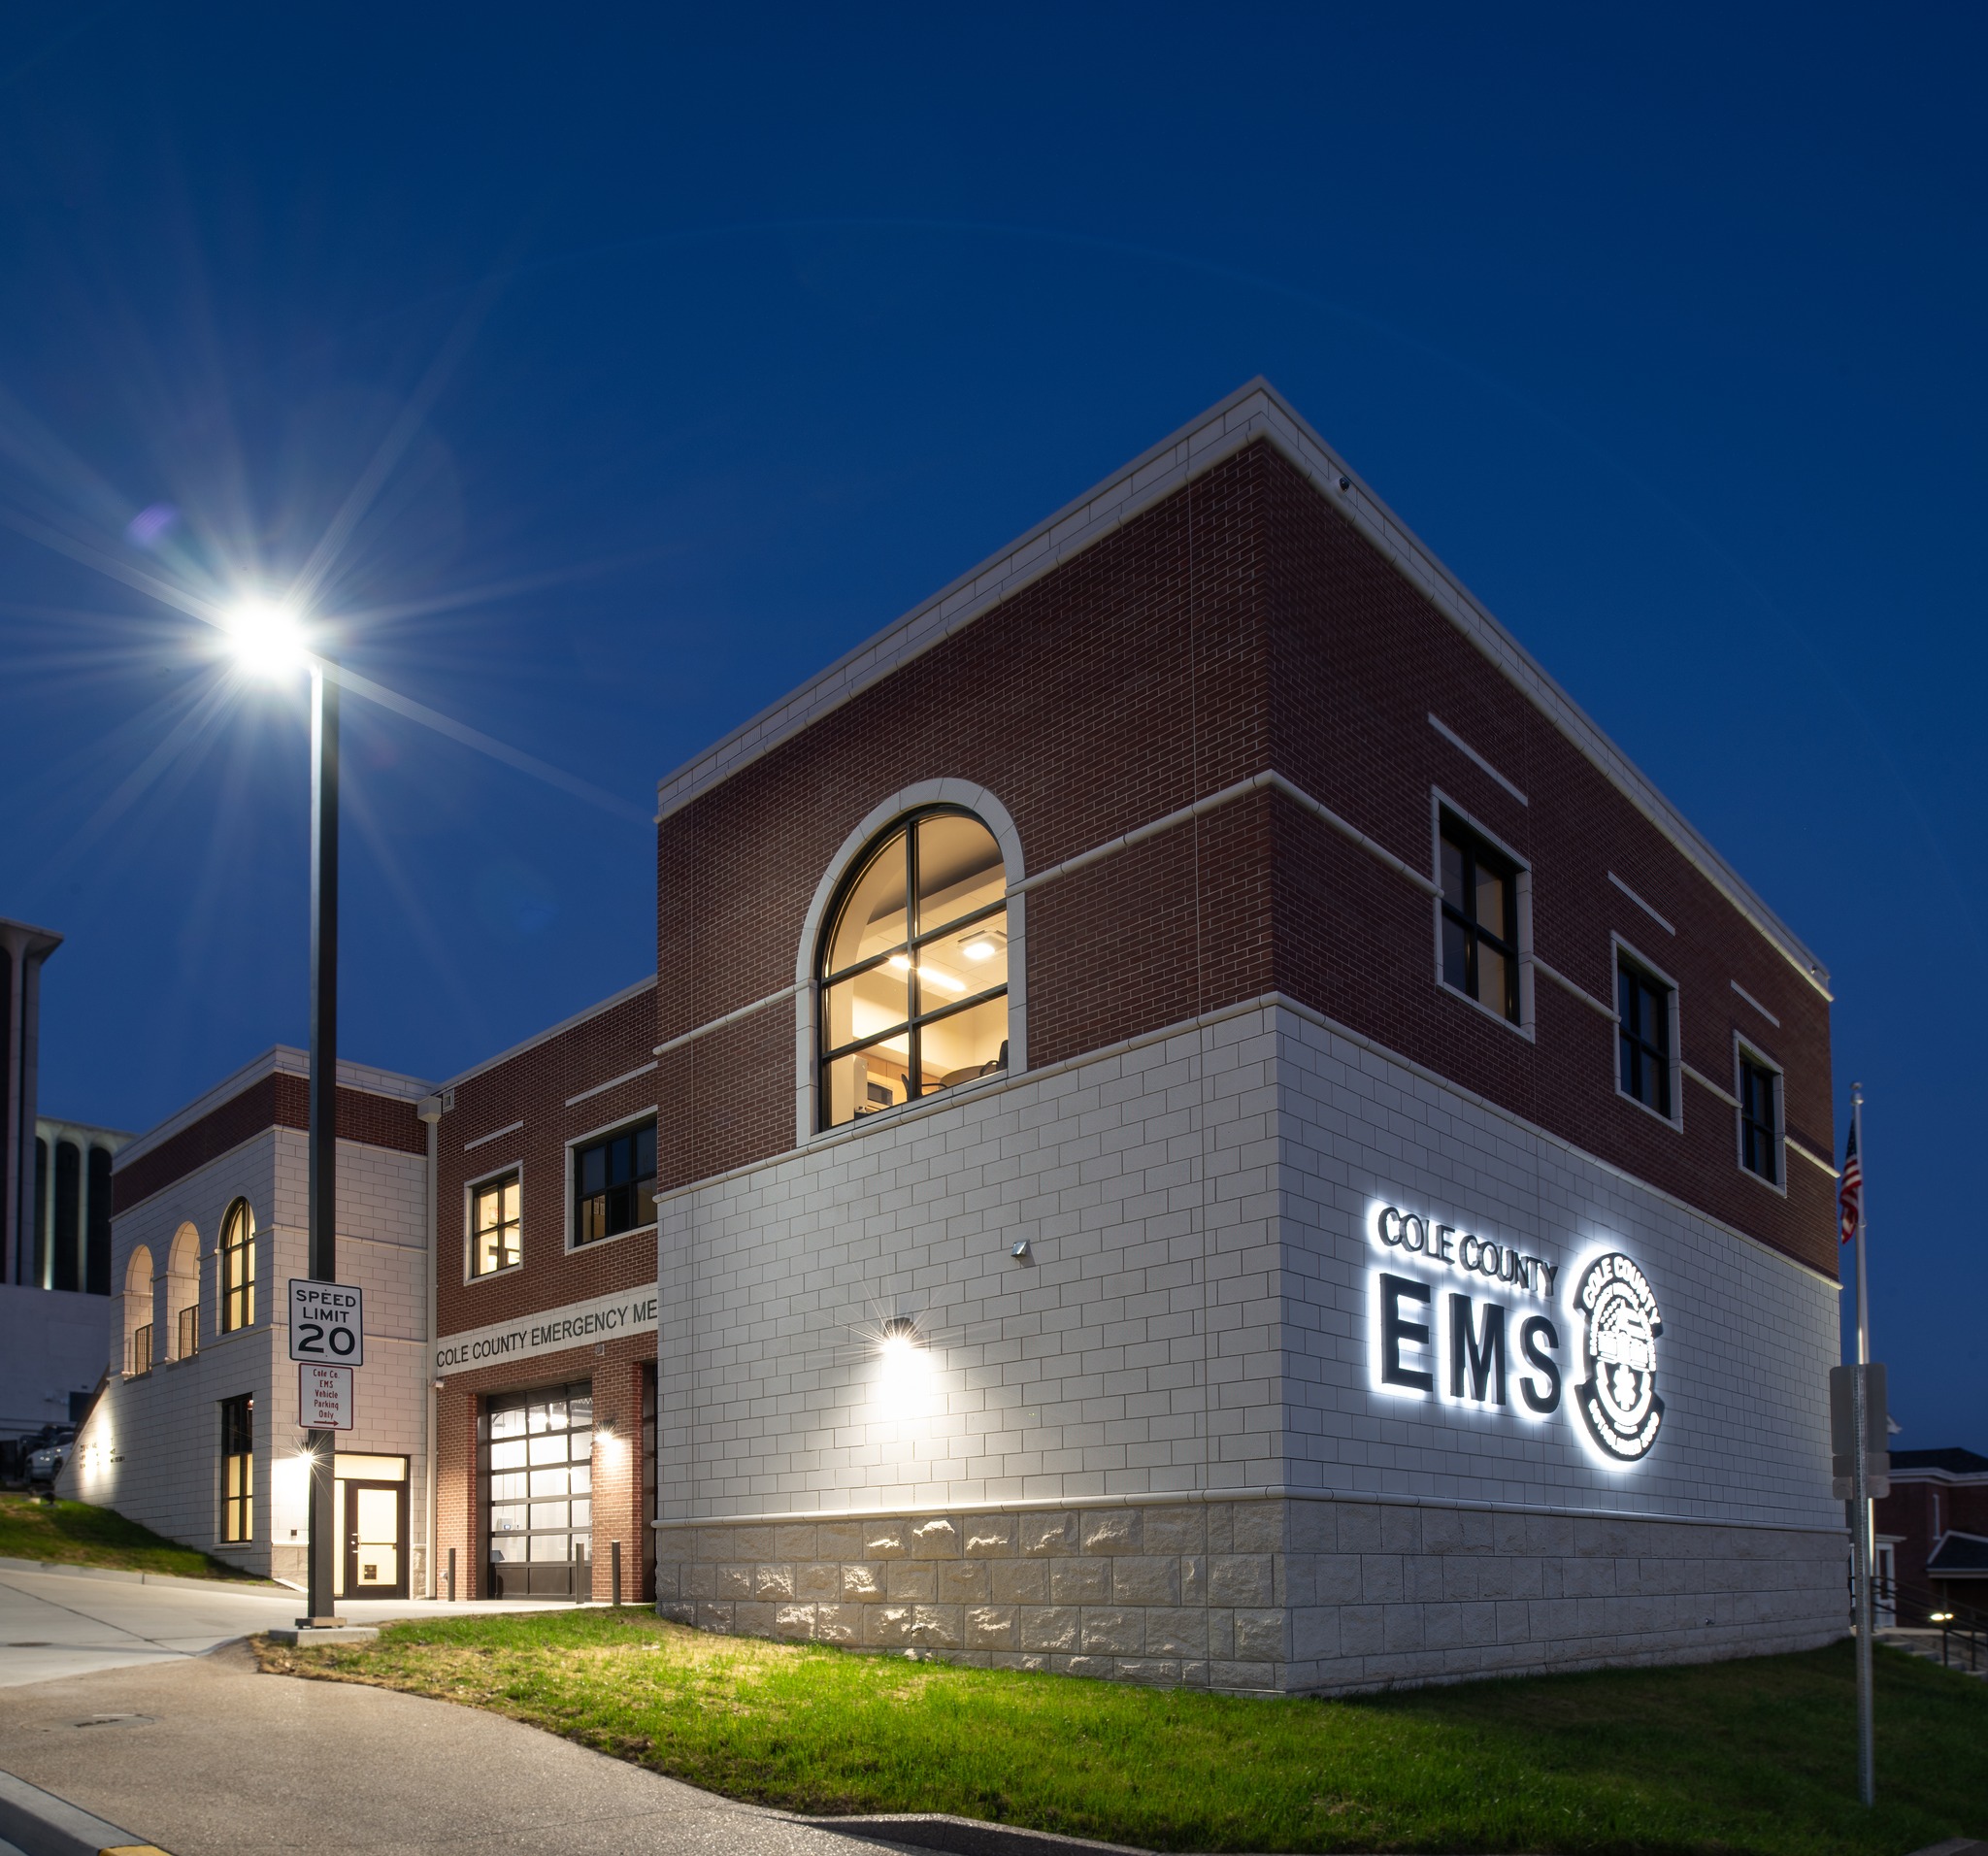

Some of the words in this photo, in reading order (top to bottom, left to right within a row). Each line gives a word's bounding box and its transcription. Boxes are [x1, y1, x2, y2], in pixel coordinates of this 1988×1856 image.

[1377, 1207, 1455, 1265] COLE
[1459, 1235, 1559, 1296] COUNTY
[296, 1289, 356, 1308] SPEED
[303, 1307, 349, 1323] LIMIT
[298, 1323, 356, 1356] 20
[437, 1344, 469, 1368] COLE
[472, 1331, 527, 1360] COUNTY
[531, 1306, 629, 1347] EMERGENCY
[1379, 1273, 1561, 1413] EMS
[313, 1369, 327, 1377] Cole
[329, 1370, 340, 1378] Co.
[319, 1379, 334, 1389] EMS
[315, 1389, 339, 1399] Vehicle
[314, 1399, 339, 1410] Parking
[318, 1409, 334, 1420] Only
